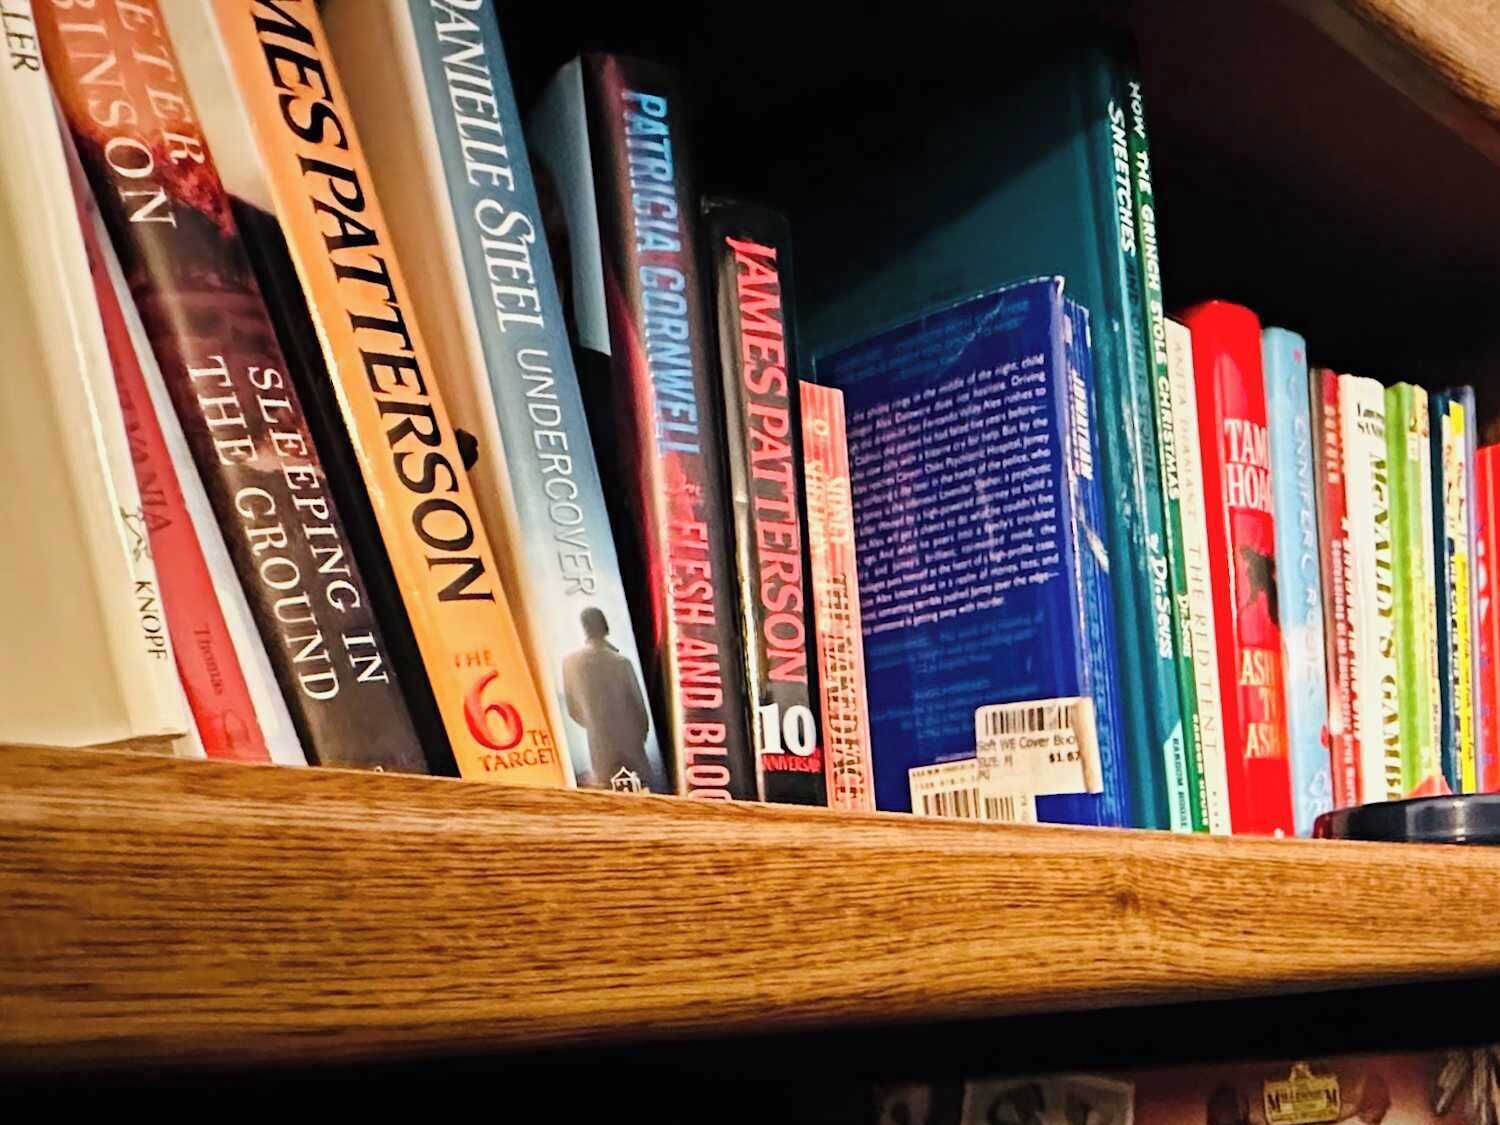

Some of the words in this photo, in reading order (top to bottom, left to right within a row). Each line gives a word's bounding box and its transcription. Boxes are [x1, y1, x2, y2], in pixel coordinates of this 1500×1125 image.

[3, 8, 41, 73] LER
[1128, 81, 1147, 139] HOW
[621, 88, 682, 254] PATRICIA
[1108, 98, 1136, 257] SNEETCHES
[1135, 150, 1153, 196] THE
[472, 197, 548, 333] STEEL
[1141, 203, 1161, 289] GRINCH
[637, 263, 701, 455] CORNWELL
[725, 235, 789, 397] JAMES
[1150, 300, 1168, 366] STOLE
[298, 155, 497, 605] PATTERSON
[514, 348, 599, 599] UNDERCOVER
[1157, 375, 1180, 500] CHRISTMAS
[187, 354, 259, 467] THE
[233, 485, 339, 701] GROUND
[247, 366, 362, 614] SLEEPING
[341, 629, 391, 686] IN
[745, 403, 809, 685] PATTERSON
[668, 521, 716, 626] FLESH
[133, 579, 168, 661] KNOPF
[193, 622, 224, 696] Thomas
[453, 649, 494, 670] THE
[1155, 593, 1174, 660] Seuss
[677, 637, 723, 709] AND
[476, 745, 557, 773] TARGET
[758, 702, 817, 757] 10
[1019, 735, 1050, 748] Cover
